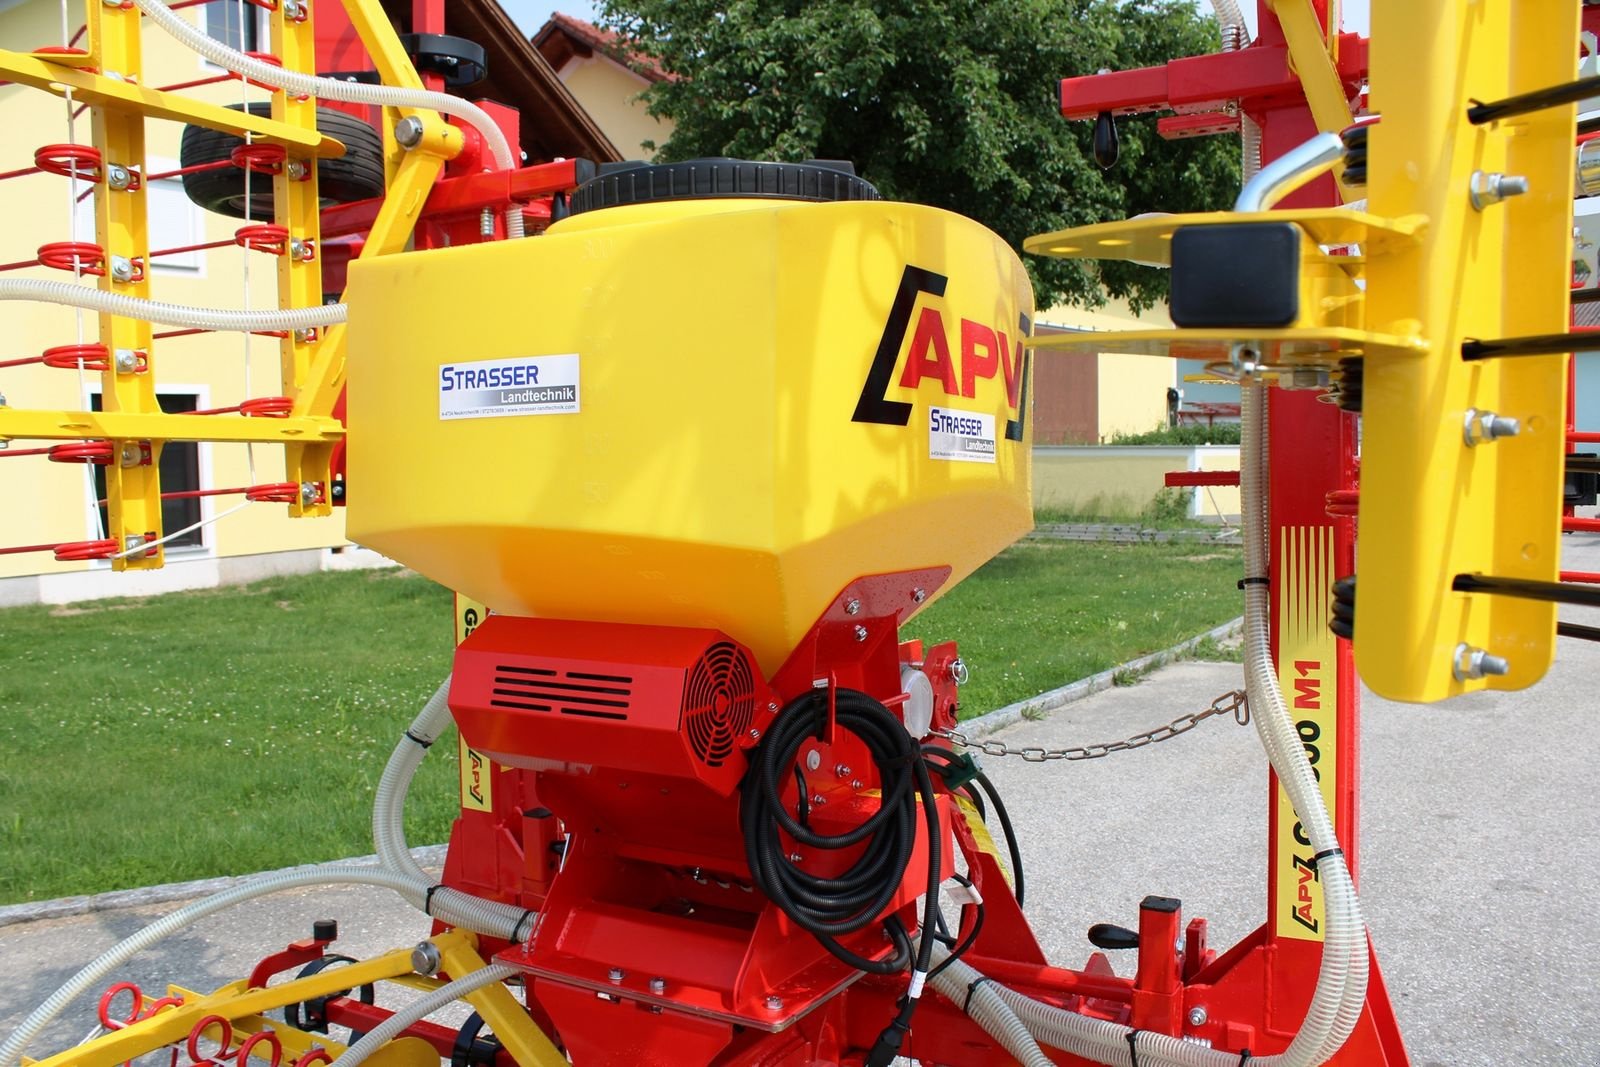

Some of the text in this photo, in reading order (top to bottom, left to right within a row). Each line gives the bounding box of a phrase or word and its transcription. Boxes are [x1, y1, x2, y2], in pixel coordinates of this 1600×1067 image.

[441, 365, 539, 392] STRASSER
[899, 307, 1023, 409] APV
[500, 387, 574, 404] Landtechnik
[931, 409, 982, 436] STRASSER
[1294, 660, 1321, 709] M1
[470, 756, 482, 797] APV
[1296, 863, 1315, 925] APV
